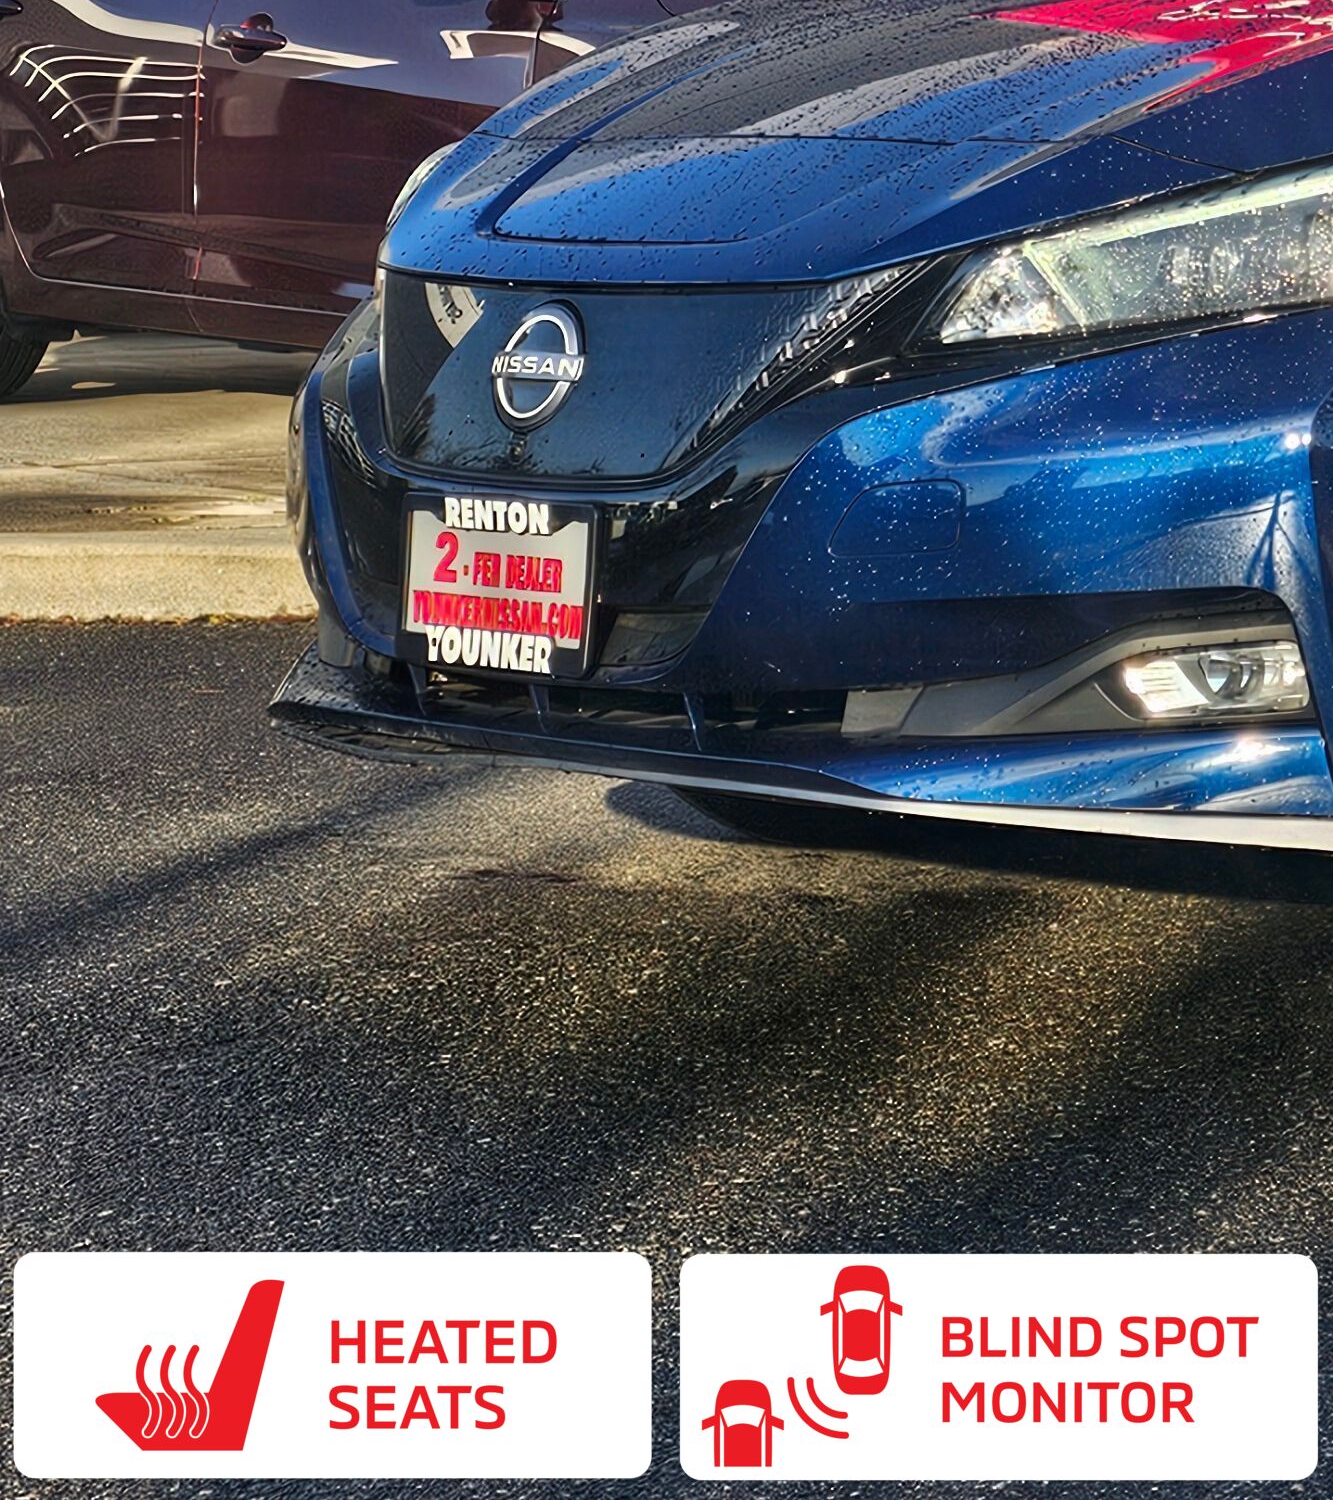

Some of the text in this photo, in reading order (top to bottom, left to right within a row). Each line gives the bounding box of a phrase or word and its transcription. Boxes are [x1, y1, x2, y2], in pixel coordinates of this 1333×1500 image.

[491, 355, 580, 379] NISSAN
[444, 497, 550, 535] RENTON
[505, 554, 563, 594] DEALER
[424, 625, 552, 675] YOUNKER
